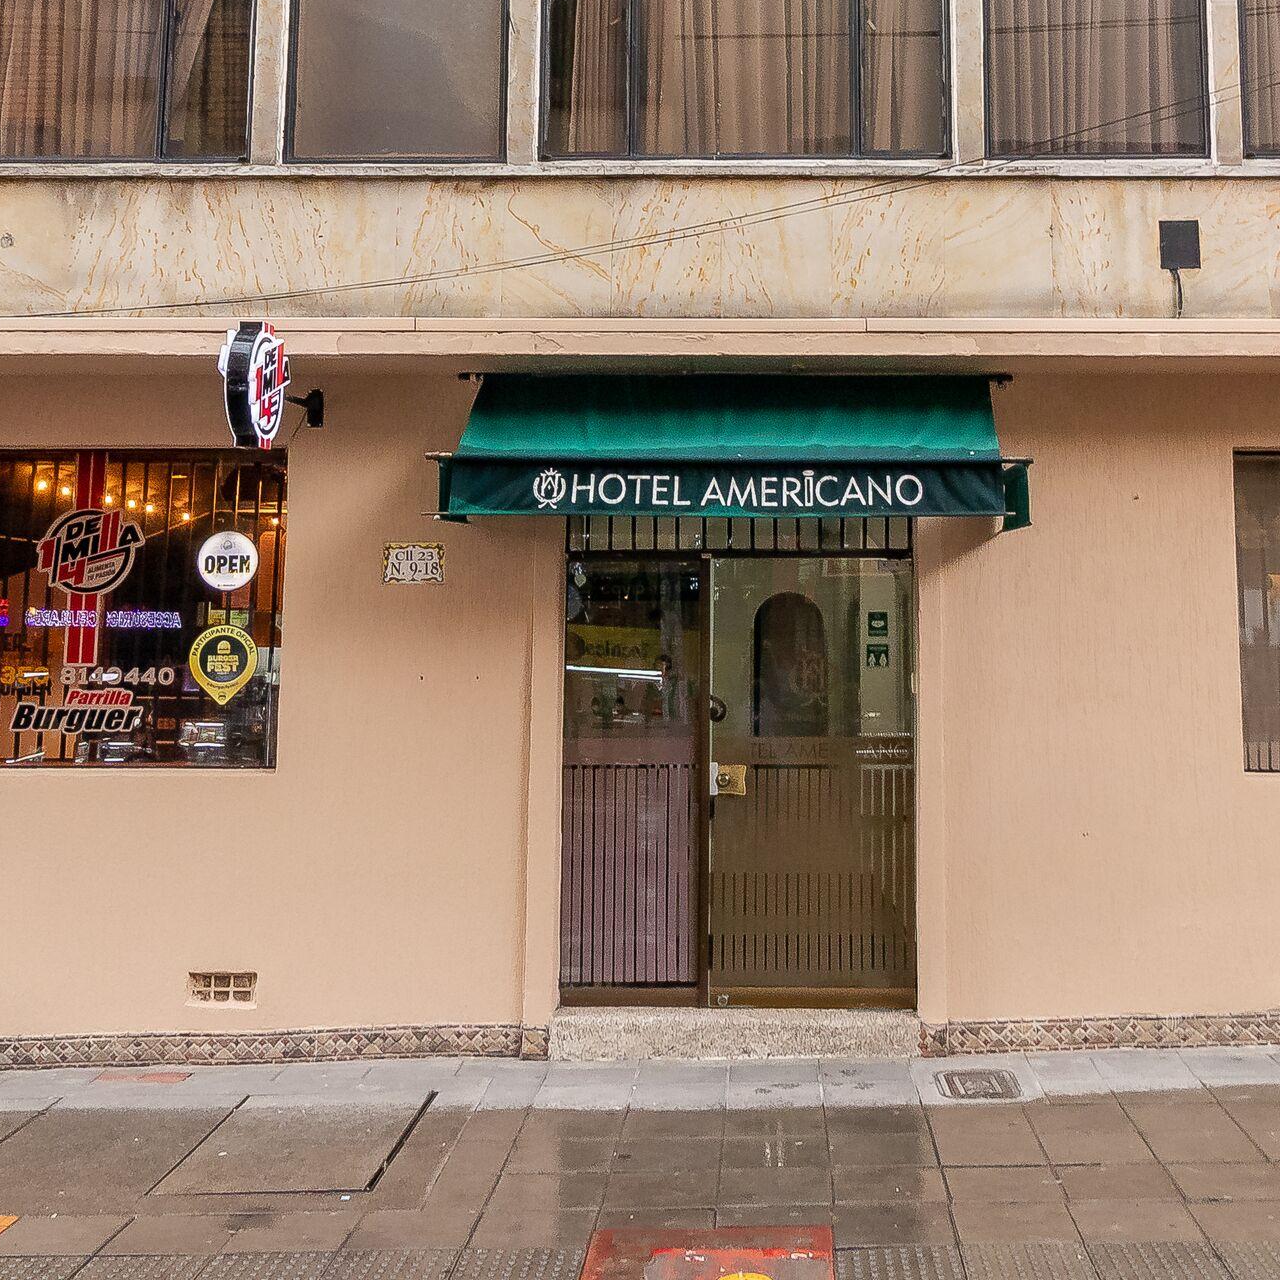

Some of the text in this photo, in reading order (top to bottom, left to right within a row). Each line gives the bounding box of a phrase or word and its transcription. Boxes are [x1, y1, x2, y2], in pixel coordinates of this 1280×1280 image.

[571, 469, 923, 507] HOTEL AMERICANO
[66, 519, 100, 540] DE
[204, 555, 251, 574] OPEN
[417, 551, 435, 561] 23
[390, 562, 440, 577] N. 9-18
[192, 627, 256, 657] PARTICIPANTE OFICIAL
[207, 662, 240, 672] FEST
[68, 690, 133, 706] Parrilla
[10, 704, 142, 732] Burguer
